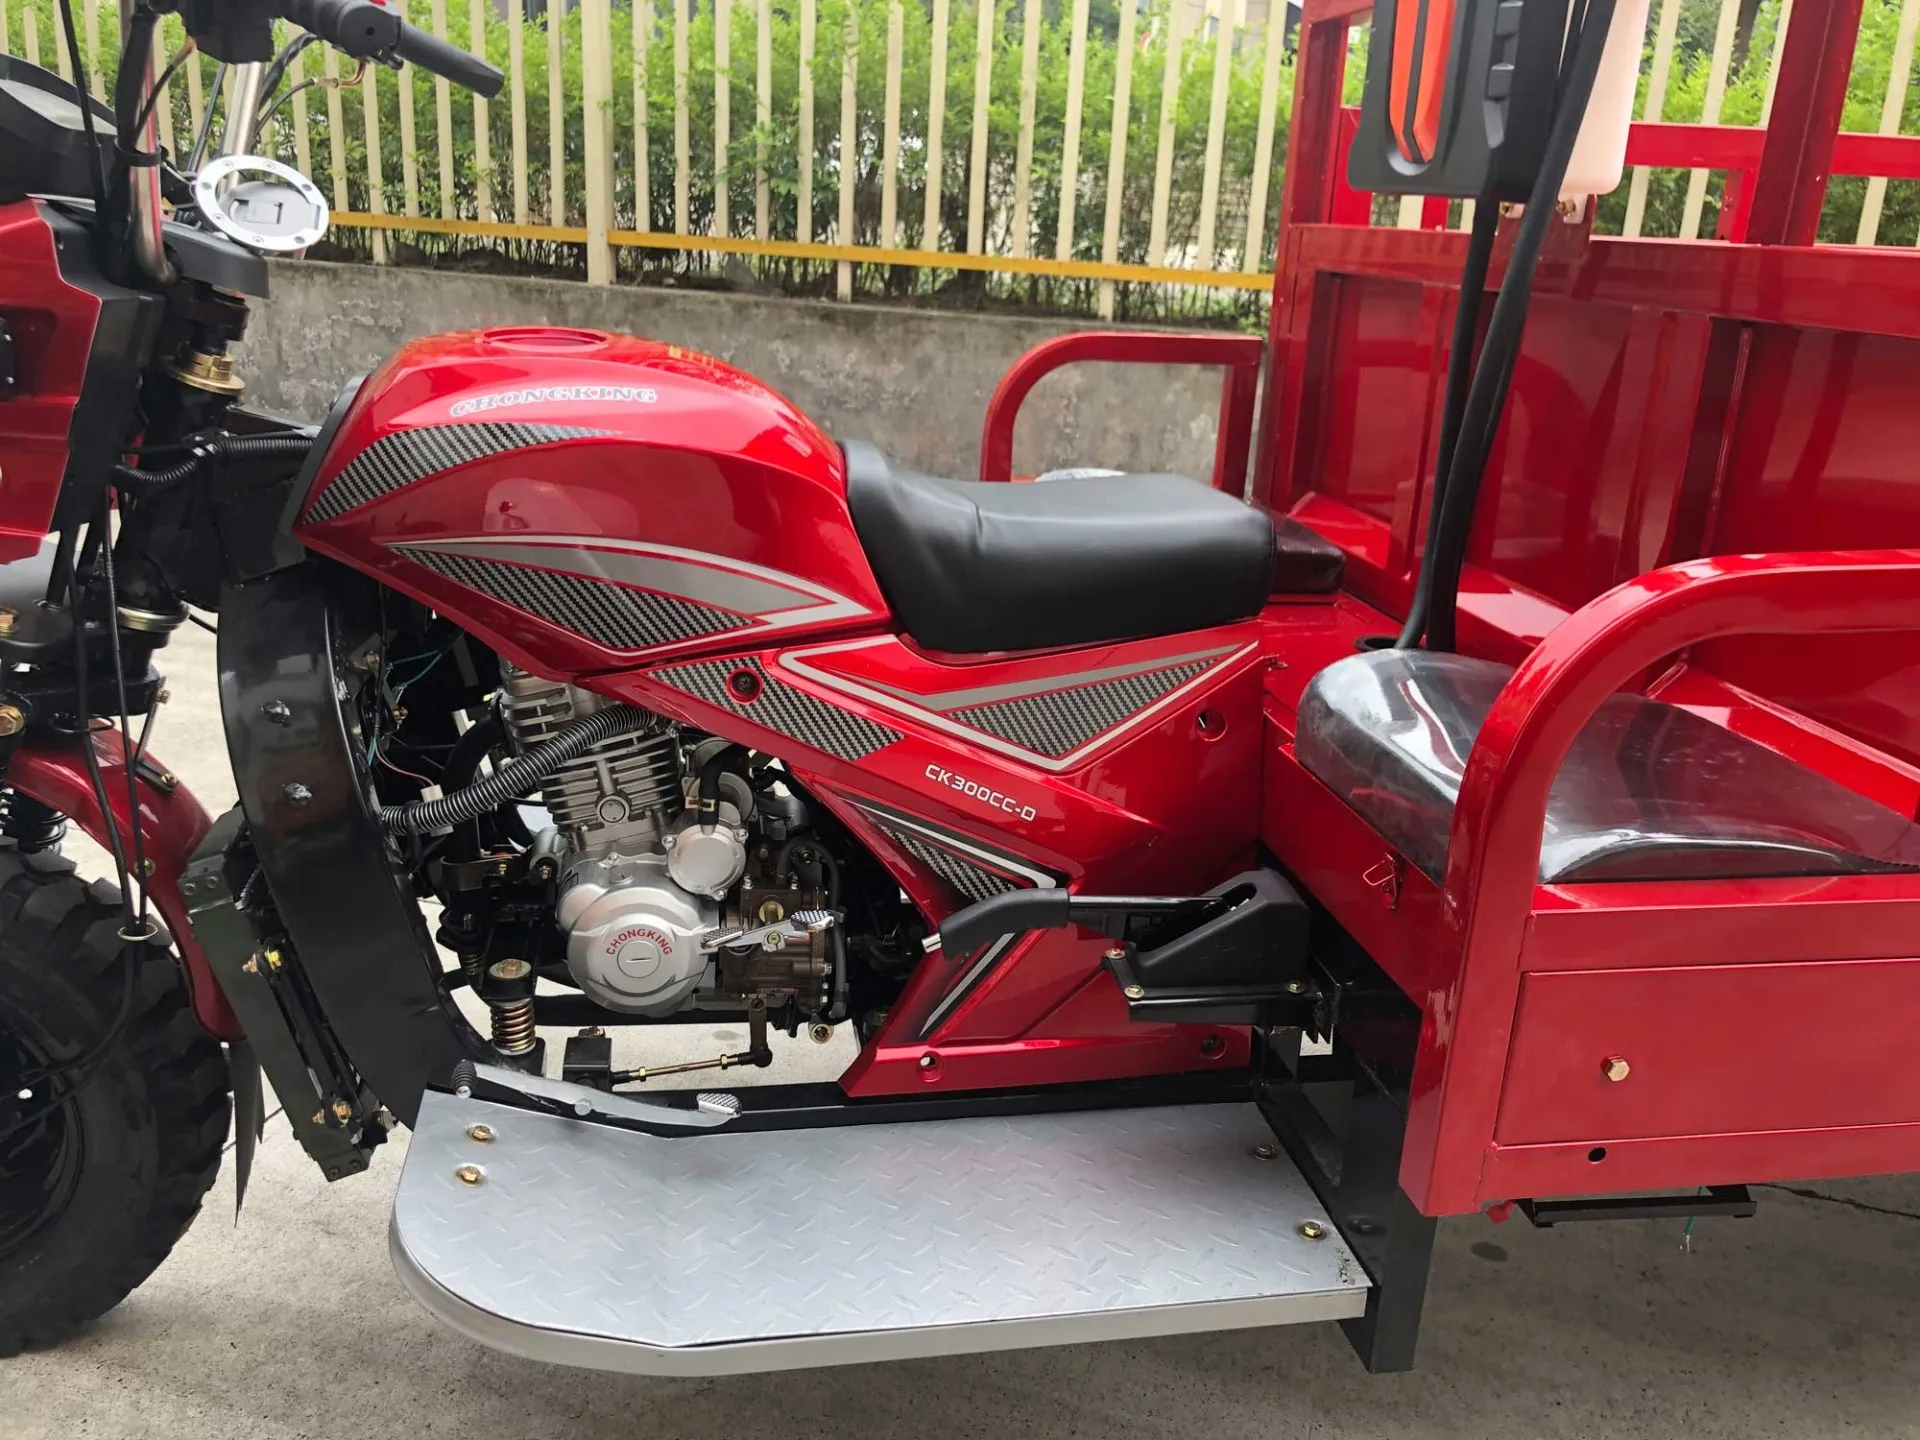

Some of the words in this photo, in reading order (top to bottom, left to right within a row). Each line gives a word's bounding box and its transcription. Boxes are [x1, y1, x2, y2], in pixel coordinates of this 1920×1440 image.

[450, 386, 658, 417] CHONGKING
[925, 763, 1037, 822] CK300CC-D
[606, 928, 673, 956] CHONGKING
